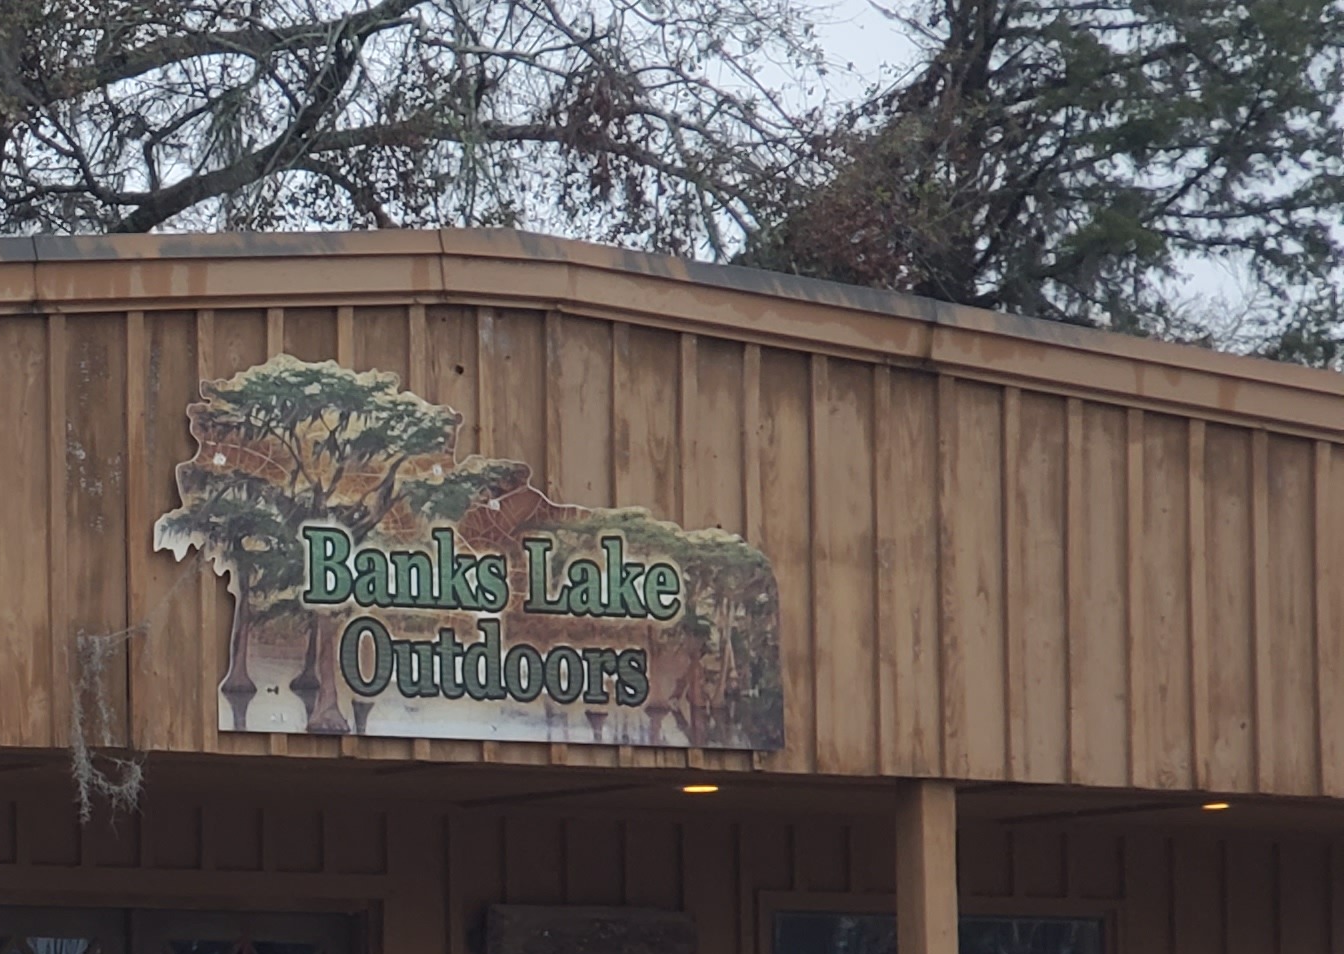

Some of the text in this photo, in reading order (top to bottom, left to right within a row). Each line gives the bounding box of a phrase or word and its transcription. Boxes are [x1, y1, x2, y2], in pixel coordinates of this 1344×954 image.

[302, 525, 682, 621] Banks Lake
[339, 615, 650, 707] Outdoors
